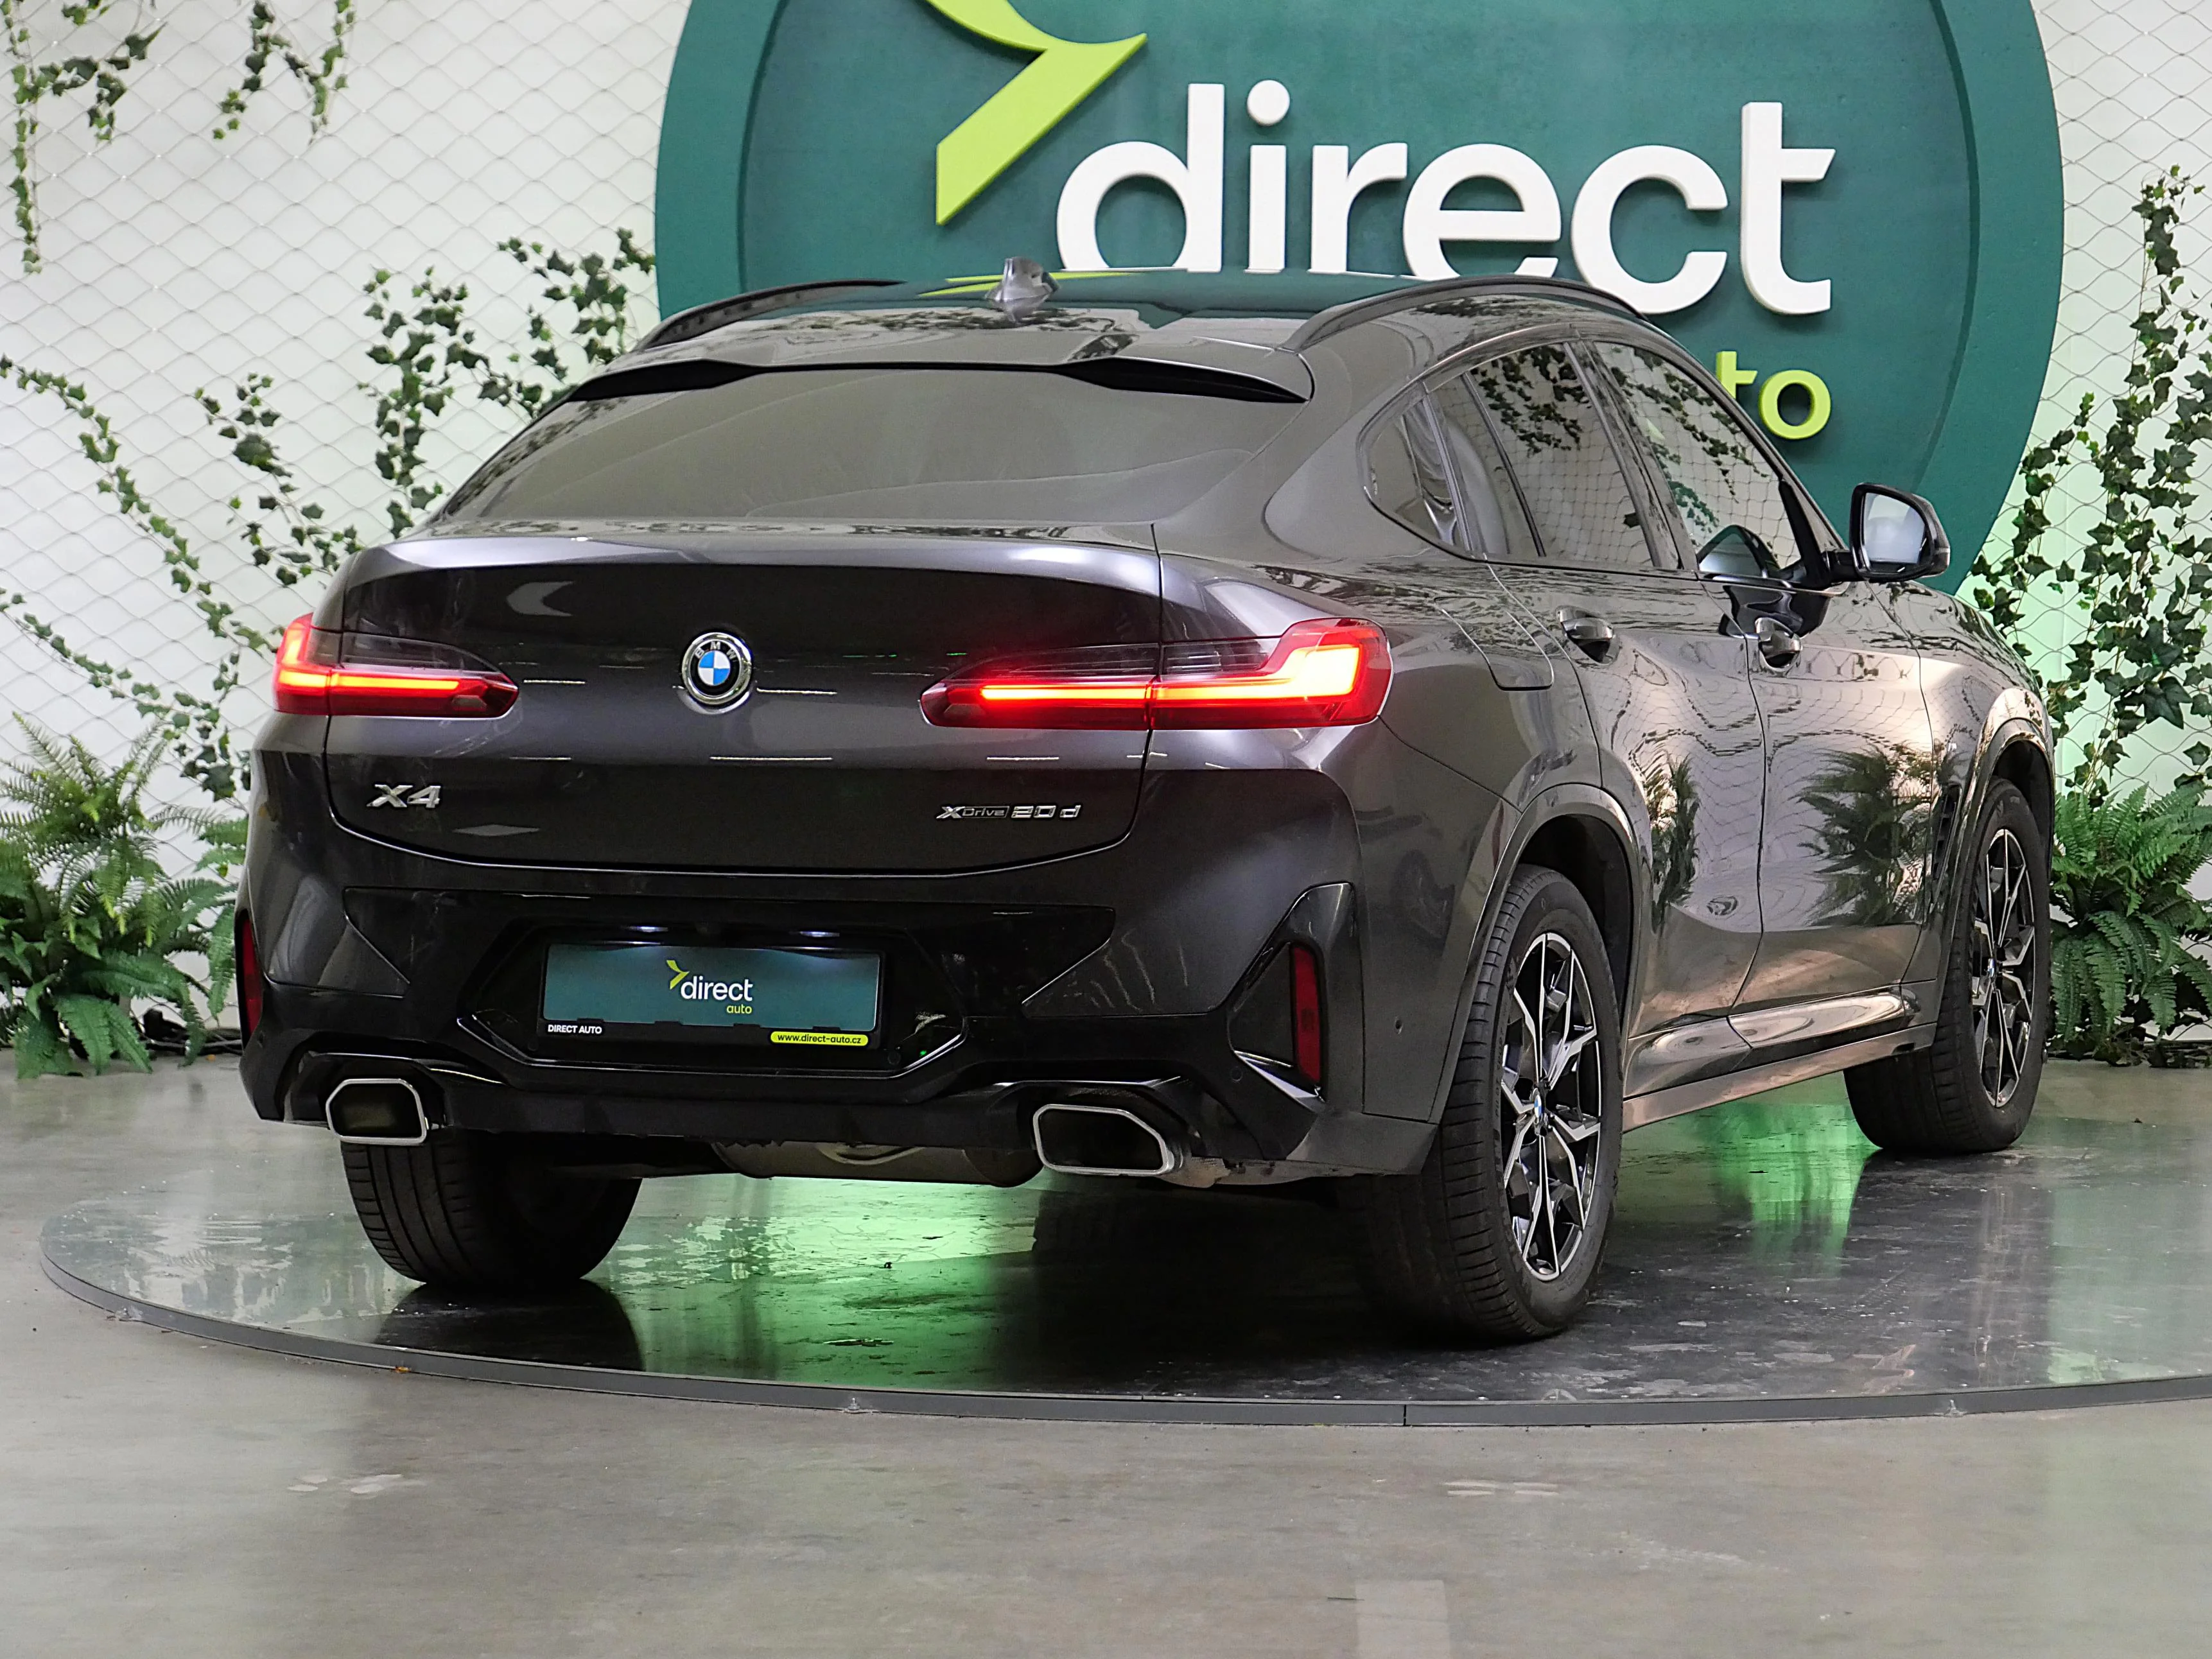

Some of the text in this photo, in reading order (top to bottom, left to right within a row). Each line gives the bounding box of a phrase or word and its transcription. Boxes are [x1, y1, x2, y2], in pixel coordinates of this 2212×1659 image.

[1056, 78, 1836, 315] direct
[1716, 351, 1832, 440] to
[694, 641, 738, 660] BMW
[366, 784, 442, 808] X4
[681, 975, 753, 1002] direct
[726, 1003, 753, 1014] auto
[548, 1024, 602, 1034] DIRECT AUTO
[777, 1034, 862, 1044] www.direct-auto.cz
